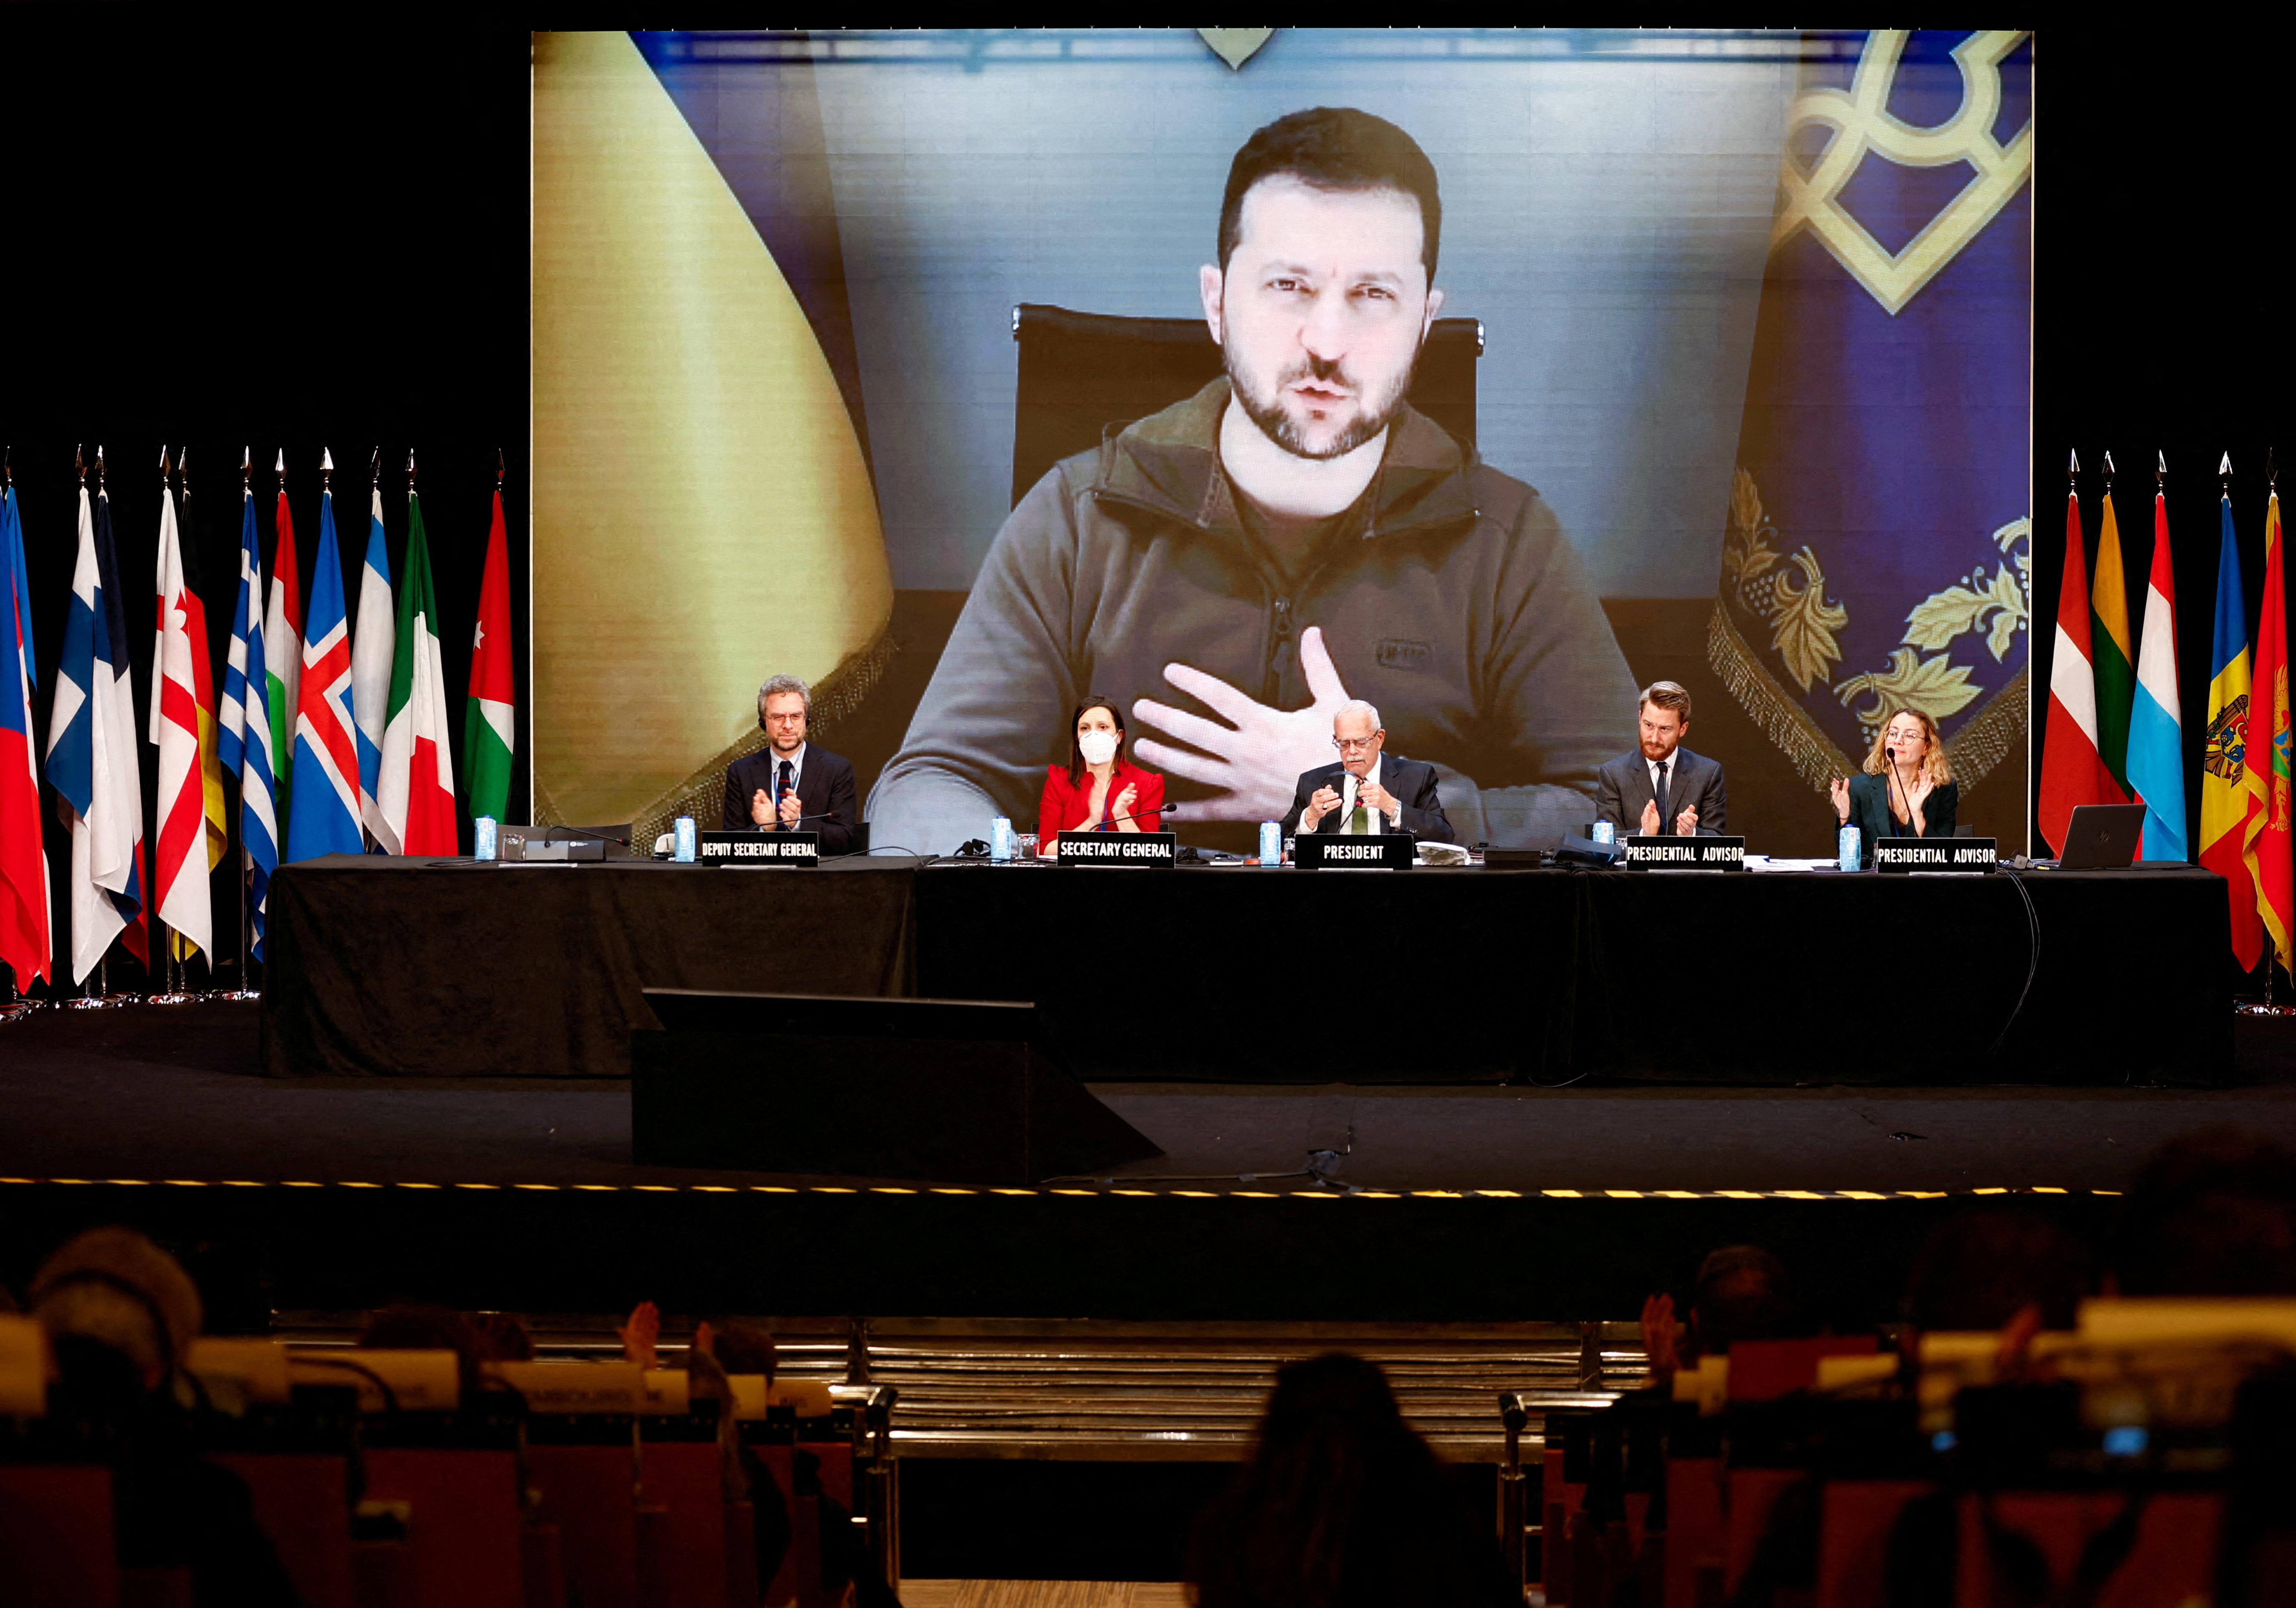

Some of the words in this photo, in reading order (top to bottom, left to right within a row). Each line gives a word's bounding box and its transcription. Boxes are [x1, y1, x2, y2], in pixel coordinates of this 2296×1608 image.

[703, 843, 731, 856] DEPUTY
[733, 843, 778, 856] SECRETARY
[780, 843, 817, 856] GENERAL
[1060, 841, 1121, 856] SECRETARY
[1123, 843, 1172, 857] GENERAL
[1324, 845, 1384, 859] PRESIDENT
[1627, 846, 1697, 861] PRESIDENTIAL
[1702, 847, 1744, 861] ADVISOR
[1878, 848, 1948, 863] PRESIDENTIAL
[1954, 848, 1995, 863] ADVISOR
